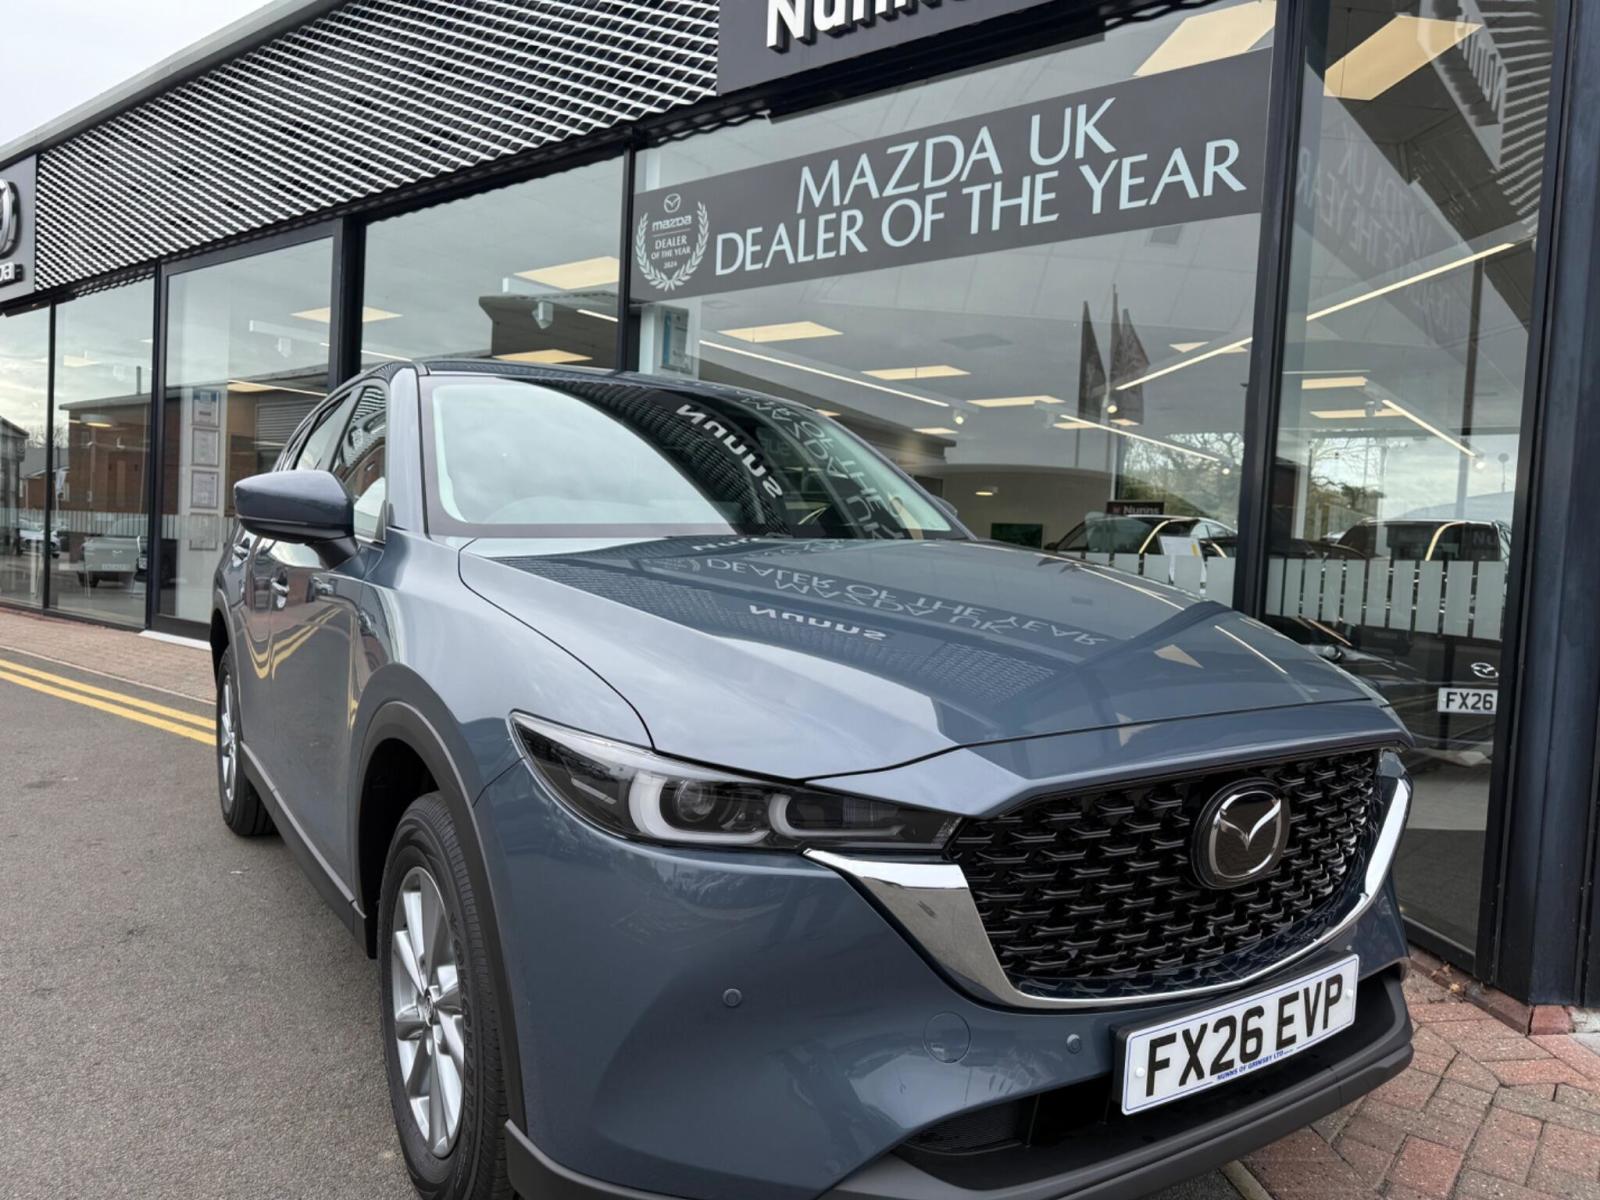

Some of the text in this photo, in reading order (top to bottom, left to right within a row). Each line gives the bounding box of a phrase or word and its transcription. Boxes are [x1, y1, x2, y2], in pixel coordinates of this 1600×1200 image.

[767, 0, 908, 47] Nu
[796, 97, 1117, 214] MAZDA UK
[652, 215, 692, 231] mazda
[715, 138, 1247, 276] DEALER OF THE YEAR
[651, 246, 691, 260] OF THE YEAR
[655, 235, 688, 250] DEALER
[1445, 691, 1494, 711] FX26
[1145, 973, 1343, 1097] FX26 EVP
